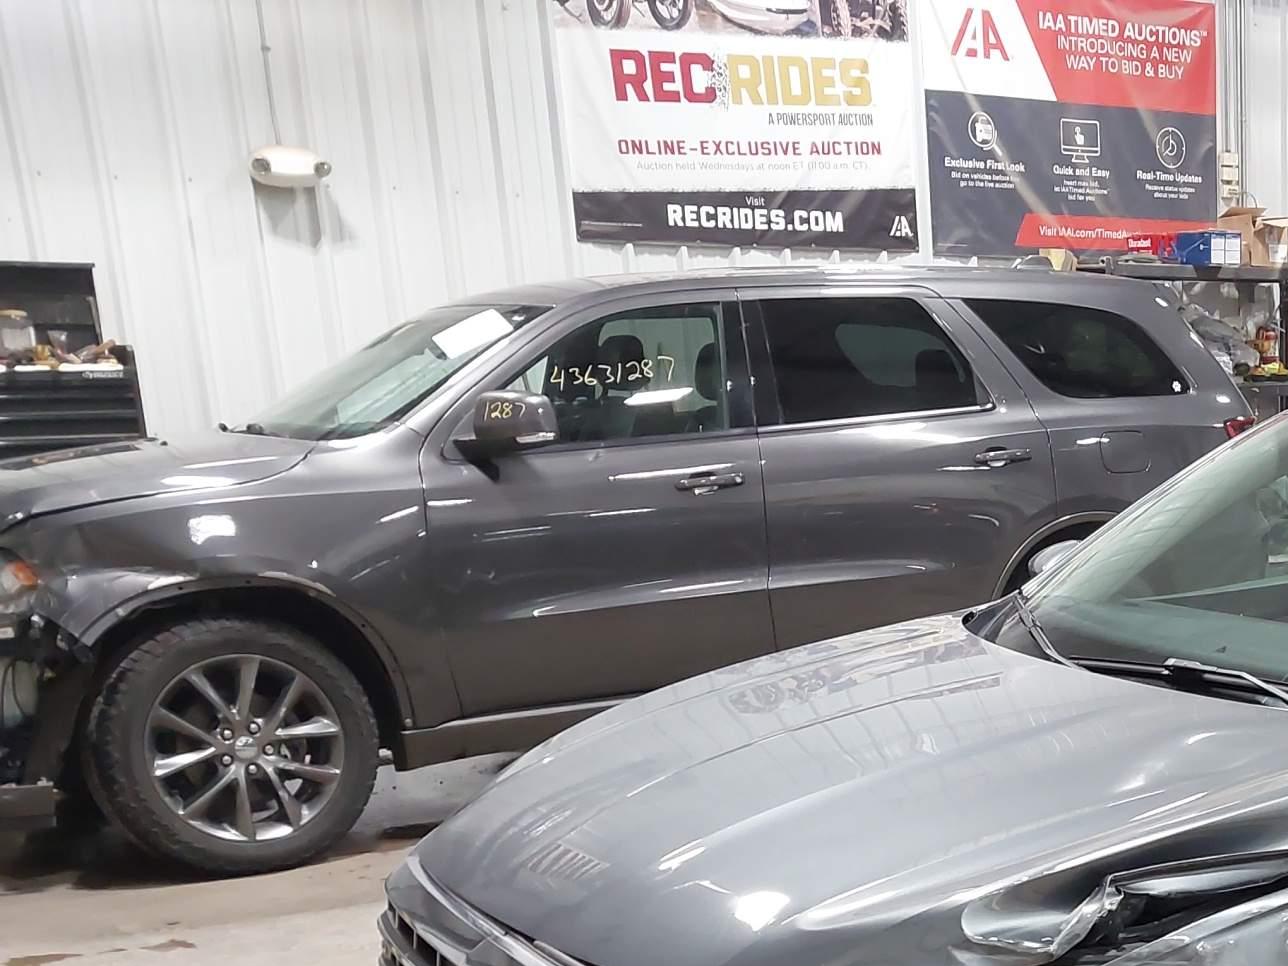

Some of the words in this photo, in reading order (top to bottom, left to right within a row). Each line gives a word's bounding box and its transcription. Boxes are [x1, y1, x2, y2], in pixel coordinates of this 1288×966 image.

[1038, 10, 1066, 32] IAA
[1067, 15, 1120, 38] TIMED
[1057, 35, 1147, 59] INTRODUCING
[1149, 46, 1160, 60] A
[1163, 47, 1193, 64] NEW
[1066, 54, 1097, 71] WAY
[1100, 57, 1118, 73] TO
[1121, 59, 1142, 76] BID
[1144, 62, 1155, 77] &
[1158, 64, 1184, 80] BUY
[609, 48, 717, 104] REC
[726, 53, 873, 107] RIDES
[768, 112, 775, 126] A
[776, 112, 836, 126] POWERSPORT
[838, 113, 874, 127] AUCTION
[617, 139, 802, 156] ONLINE-EXCLUSIVE
[809, 140, 882, 156] AUCTION
[636, 160, 673, 171] Auction
[675, 160, 696, 171] held
[944, 156, 985, 169] Exclusive
[986, 159, 1005, 170] First
[1006, 161, 1026, 173] Look
[1053, 164, 1074, 176] Quick
[1075, 167, 1089, 177] and
[1091, 167, 1110, 179] Easy
[1136, 169, 1174, 182] Real-Time
[1175, 171, 1203, 184] Updates
[745, 195, 766, 206] Visit
[666, 203, 844, 233] RECRIDES.COM
[1038, 225, 1057, 237] Visit
[550, 355, 675, 392] 43631287
[483, 401, 526, 422] 1287
